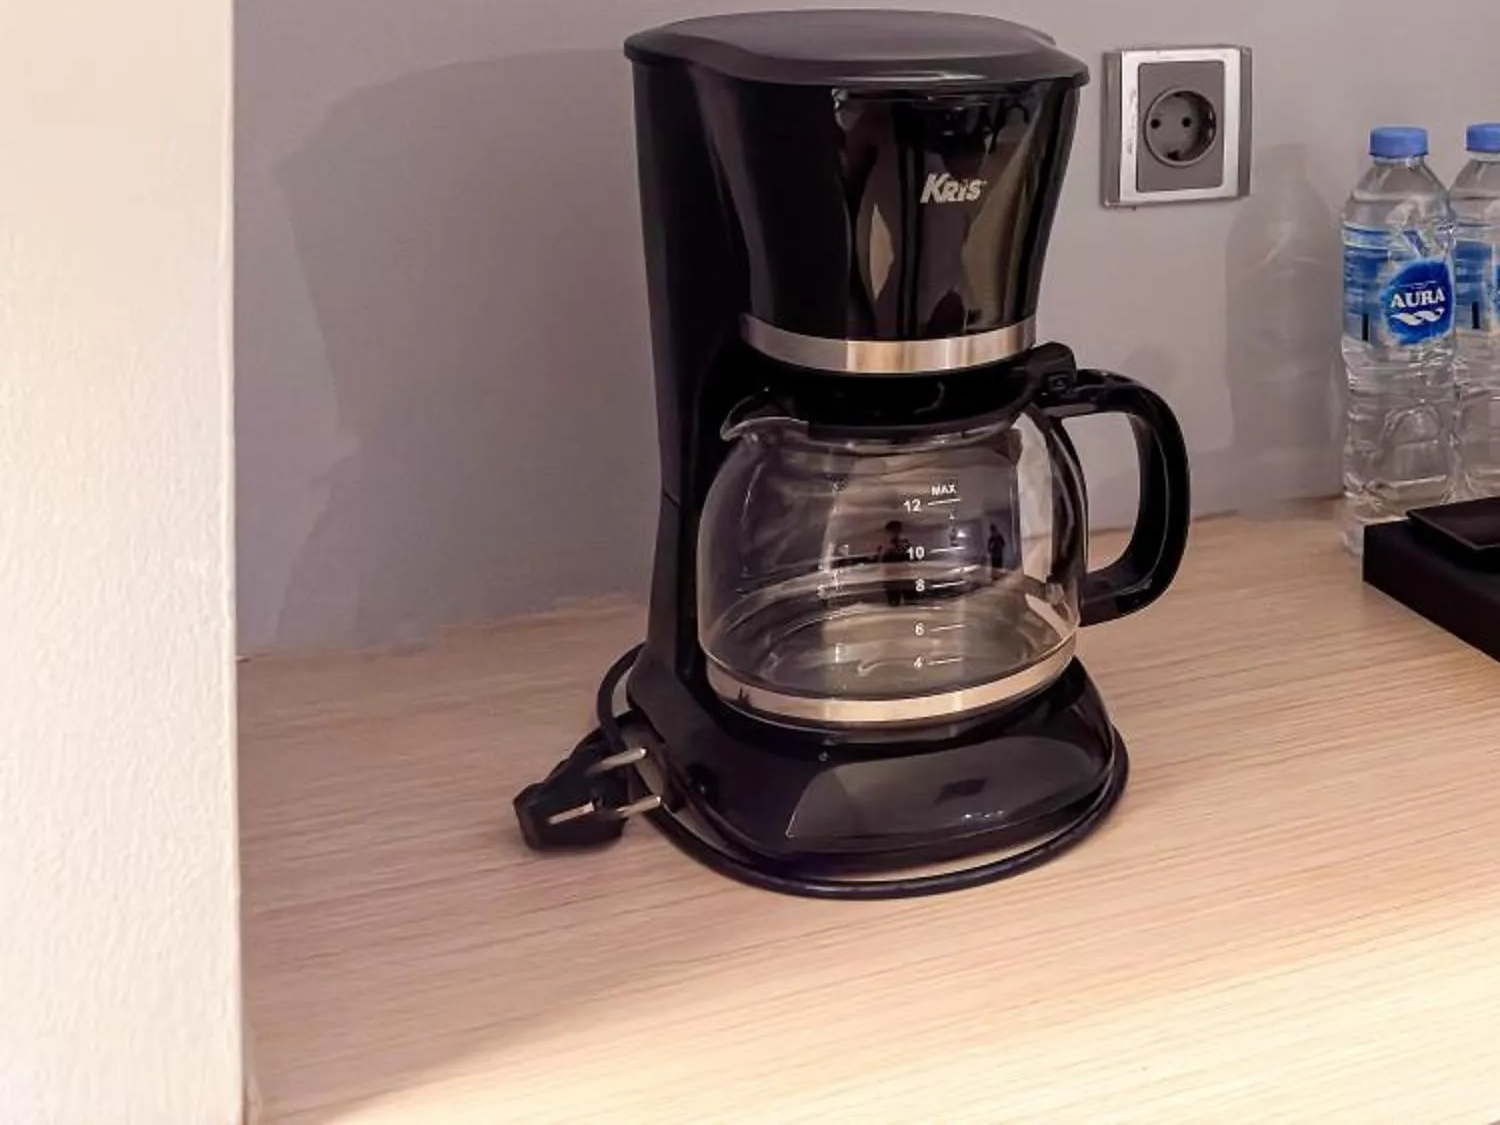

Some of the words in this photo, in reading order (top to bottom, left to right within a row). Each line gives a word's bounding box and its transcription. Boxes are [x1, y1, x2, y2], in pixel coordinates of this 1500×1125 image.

[1390, 286, 1446, 308] AURA
[931, 484, 956, 496] MAX
[904, 499, 922, 512] 12
[907, 546, 925, 560] 10
[915, 579, 925, 592] 8
[915, 624, 925, 636] 6
[913, 656, 923, 669] 4
